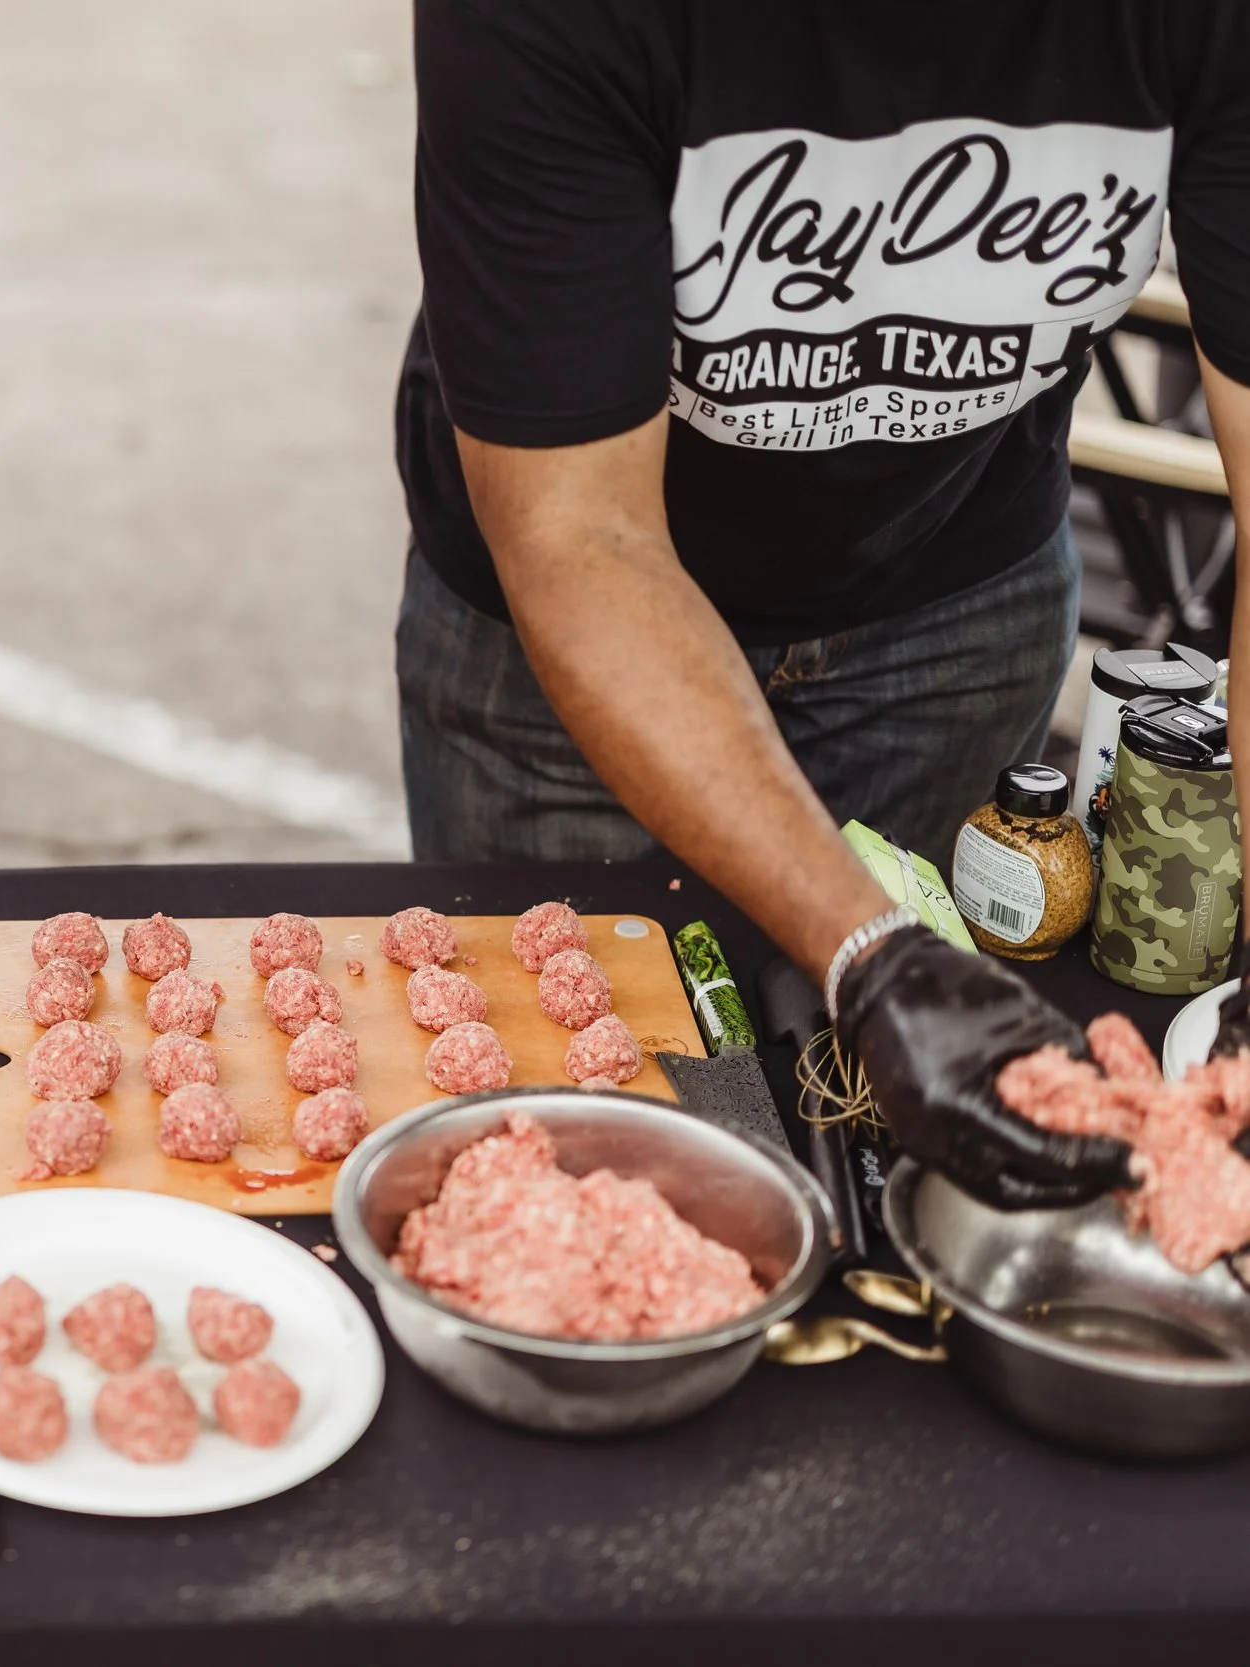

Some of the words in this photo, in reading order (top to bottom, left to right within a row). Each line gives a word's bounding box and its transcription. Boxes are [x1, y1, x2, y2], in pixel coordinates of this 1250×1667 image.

[673, 138, 884, 325] Jay
[881, 133, 1157, 307] Dee'z
[876, 325, 1020, 380] TEXAS
[699, 400, 775, 430] Best
[791, 395, 869, 429] Little
[887, 391, 1007, 420] Sports
[736, 428, 815, 448] Grill
[829, 425, 854, 446] in
[869, 415, 968, 439] Texas
[1192, 885, 1212, 957] BRÜMATE
